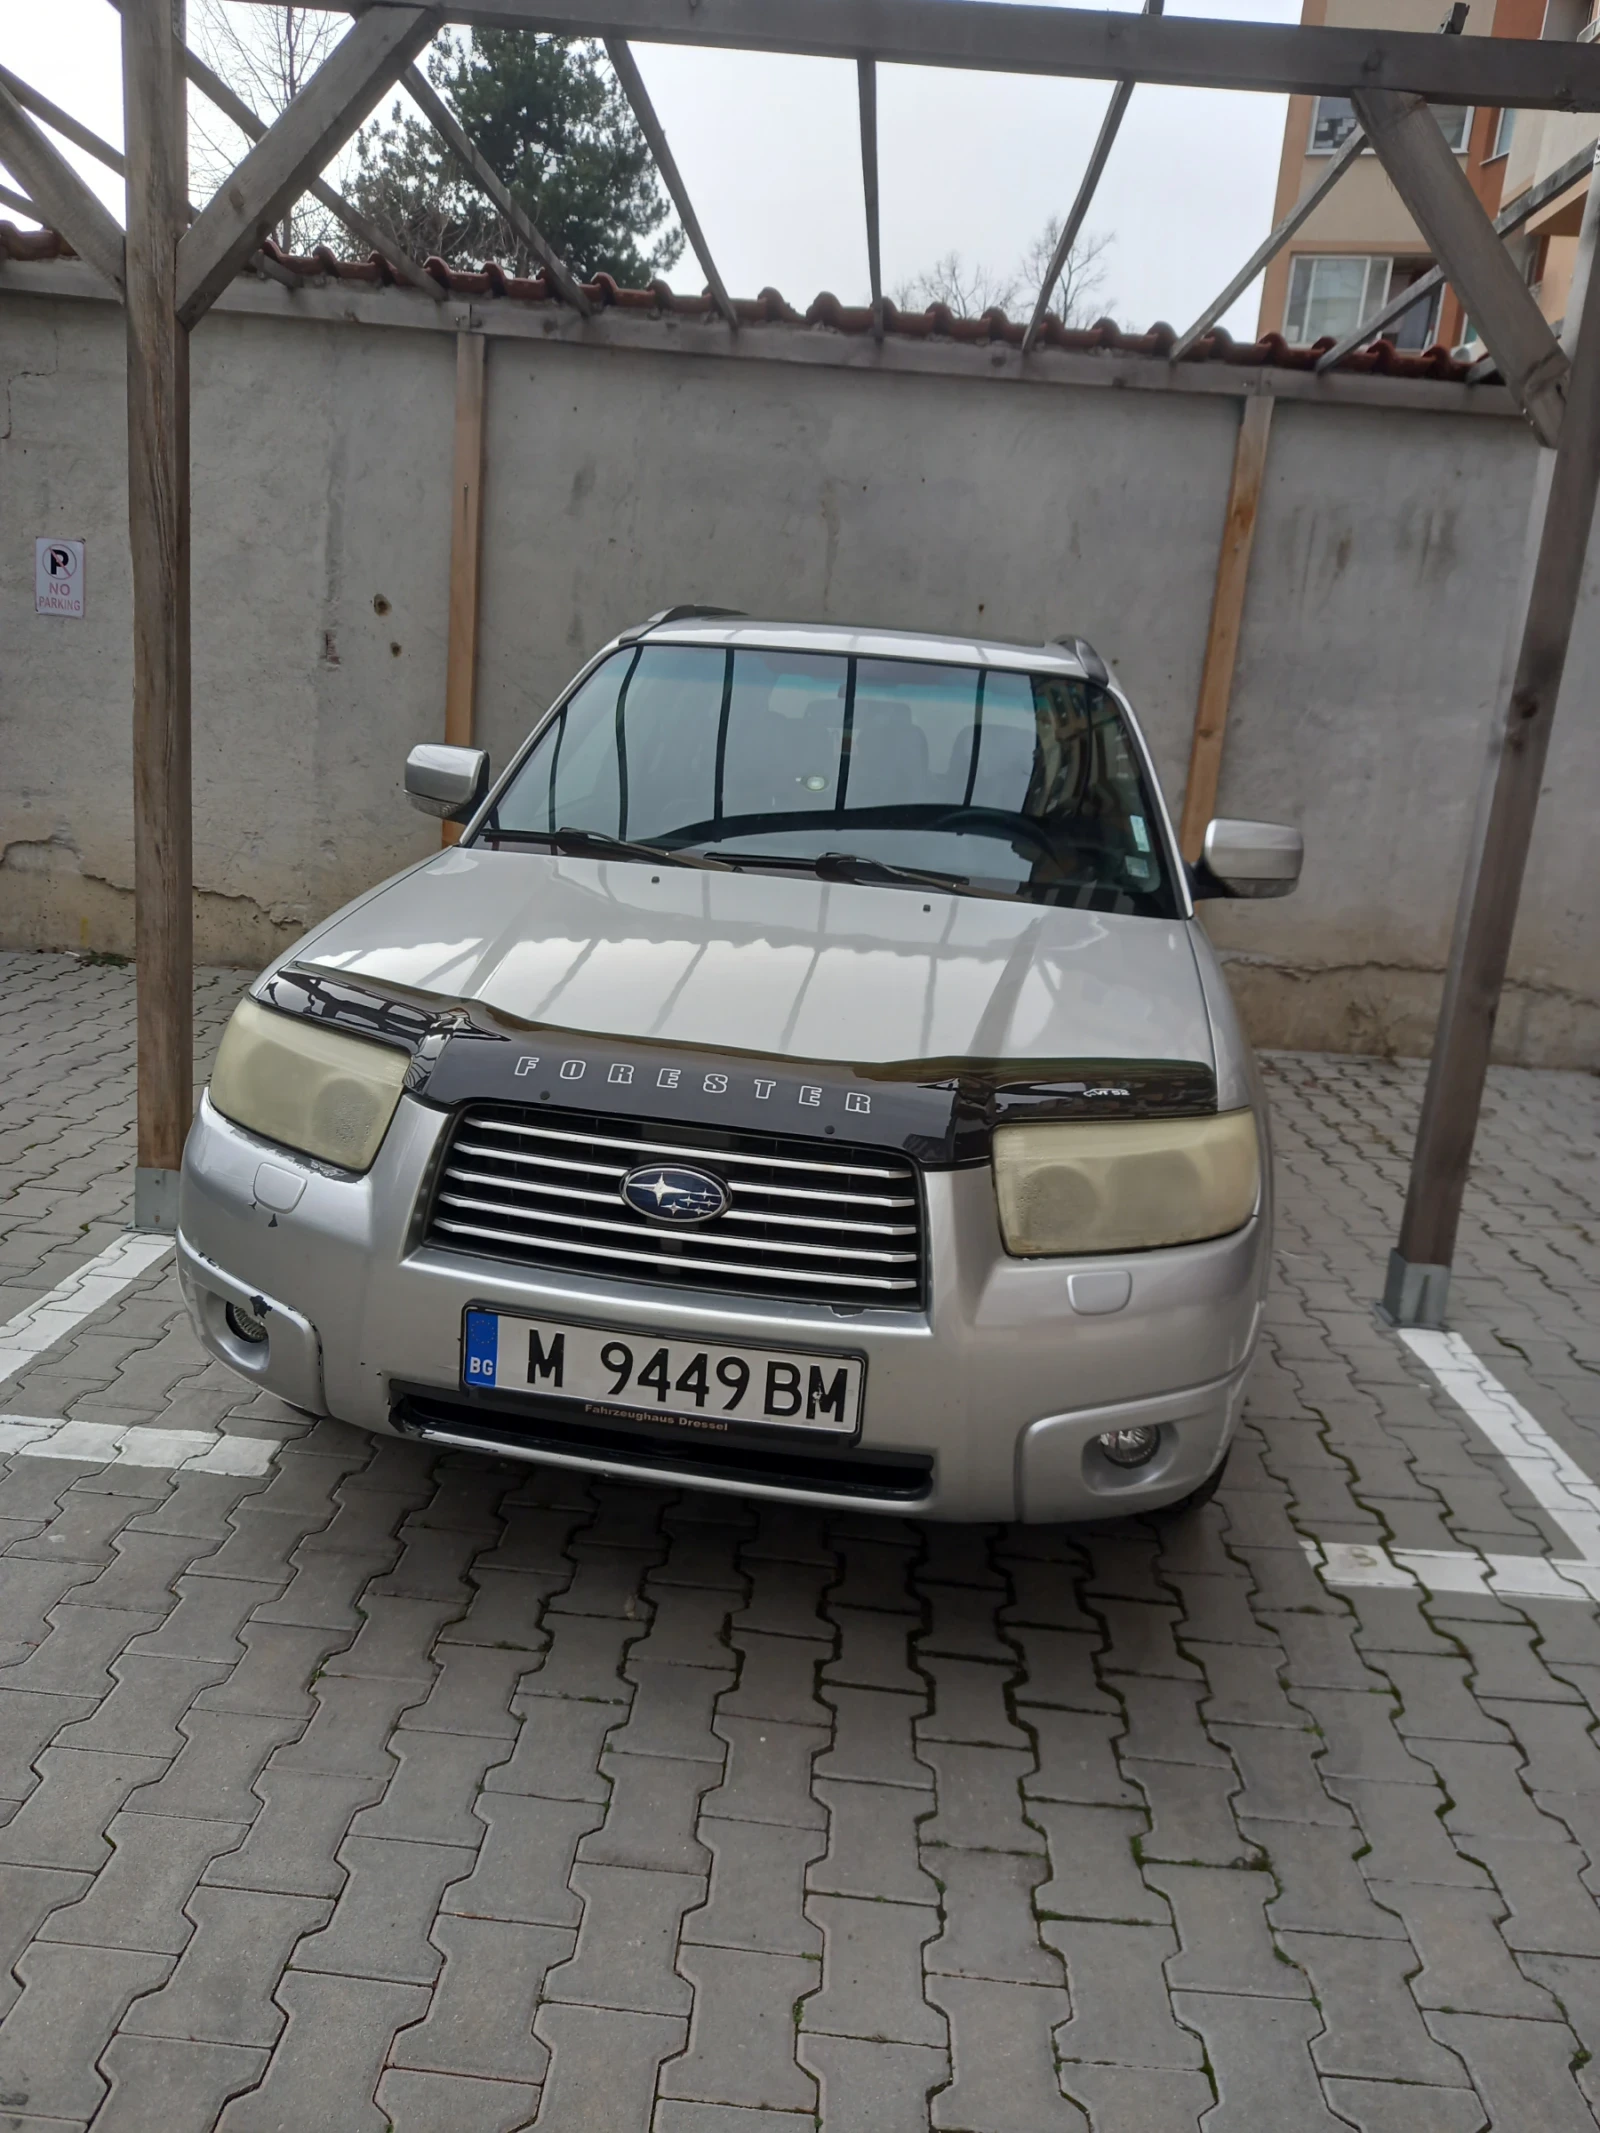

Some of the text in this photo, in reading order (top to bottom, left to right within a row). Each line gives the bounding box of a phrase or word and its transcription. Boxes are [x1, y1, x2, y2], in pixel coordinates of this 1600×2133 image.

[49, 582, 70, 596] NO
[39, 596, 80, 611] PARKING
[514, 1056, 872, 1114] FORESTER
[469, 1356, 494, 1376] BG
[526, 1327, 849, 1423] M 9449 BM
[584, 1404, 728, 1431] Fahrzeughaus Dressel
